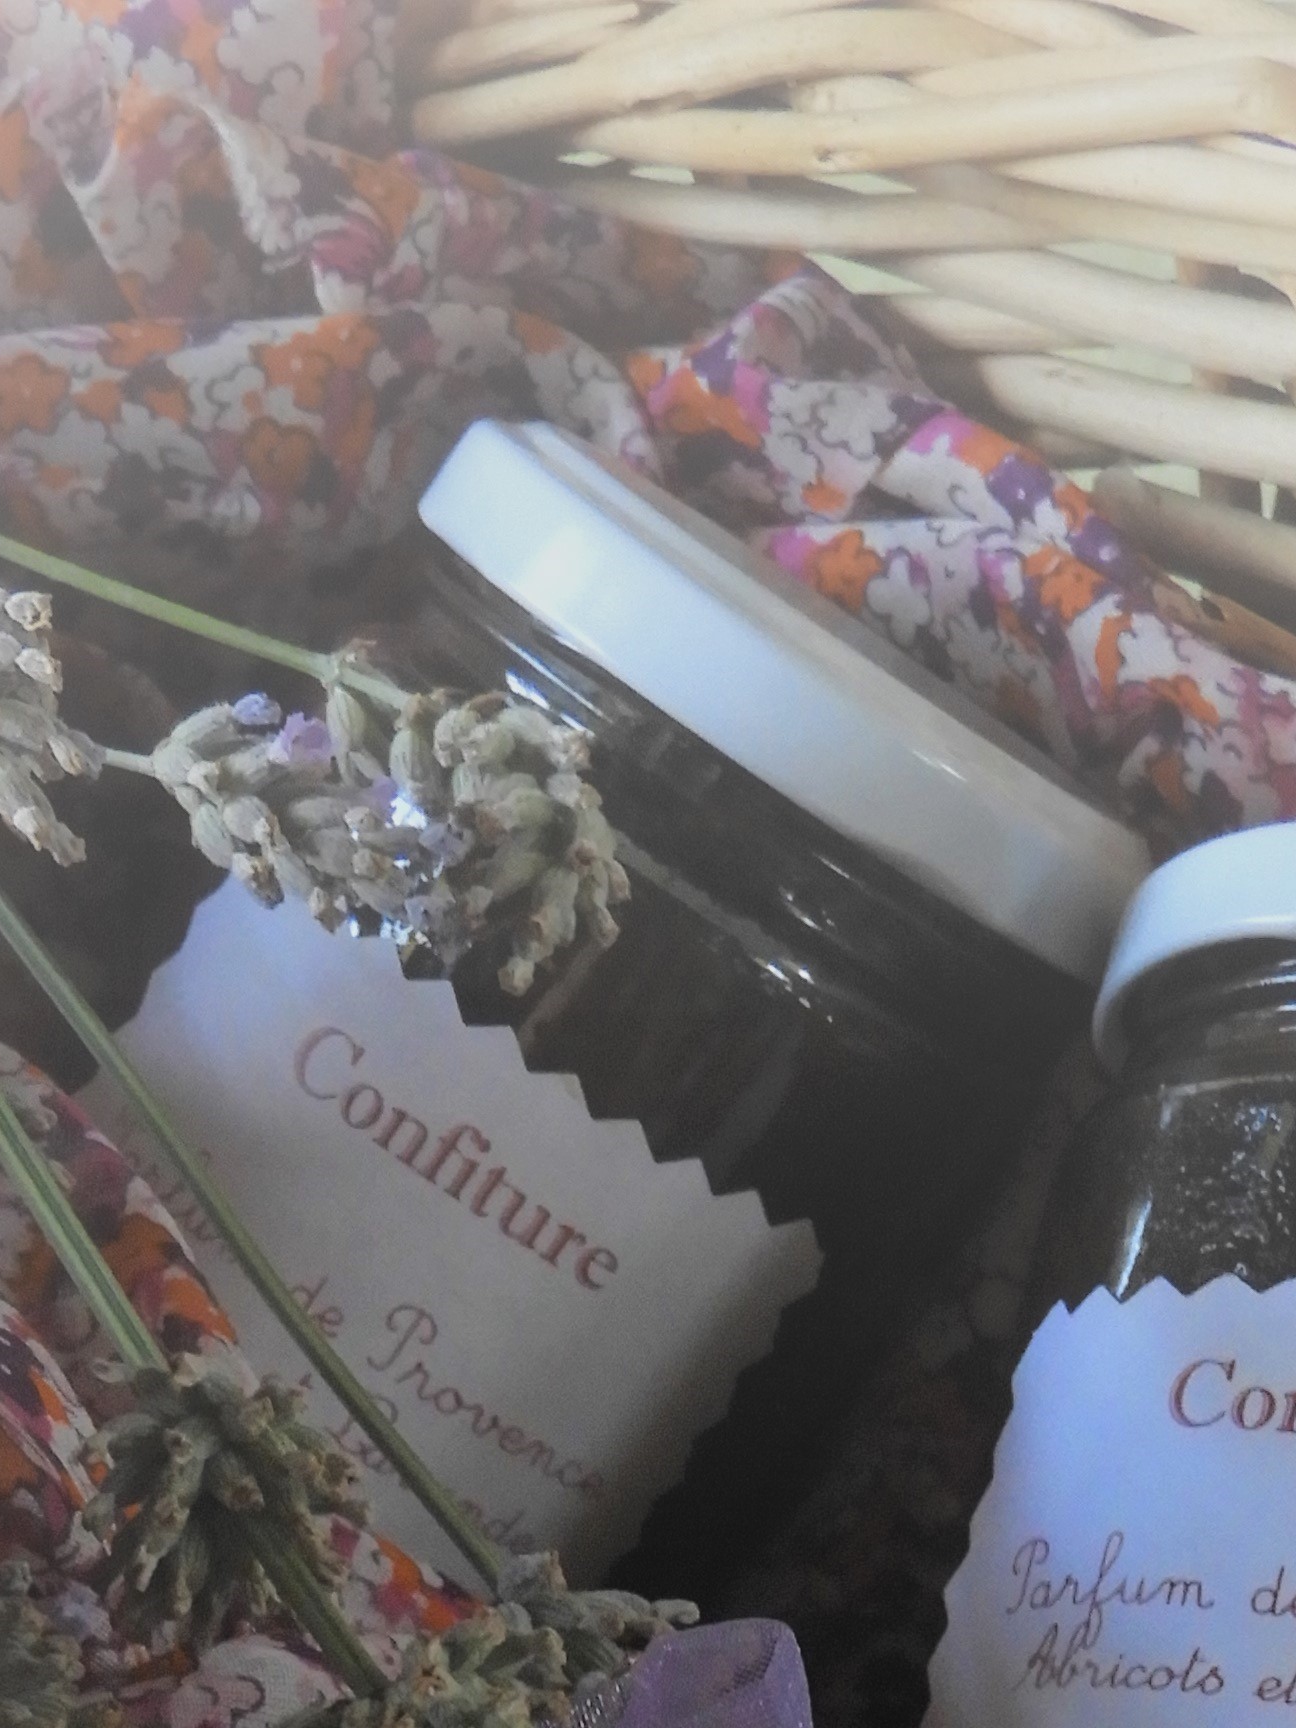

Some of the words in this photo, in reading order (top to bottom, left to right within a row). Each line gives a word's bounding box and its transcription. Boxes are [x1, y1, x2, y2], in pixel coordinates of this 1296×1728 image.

[293, 1026, 620, 1292] Confiture
[291, 1274, 344, 1338] de
[1005, 1530, 1215, 1649] Parfum
[1007, 1621, 1224, 1696] Abricots
